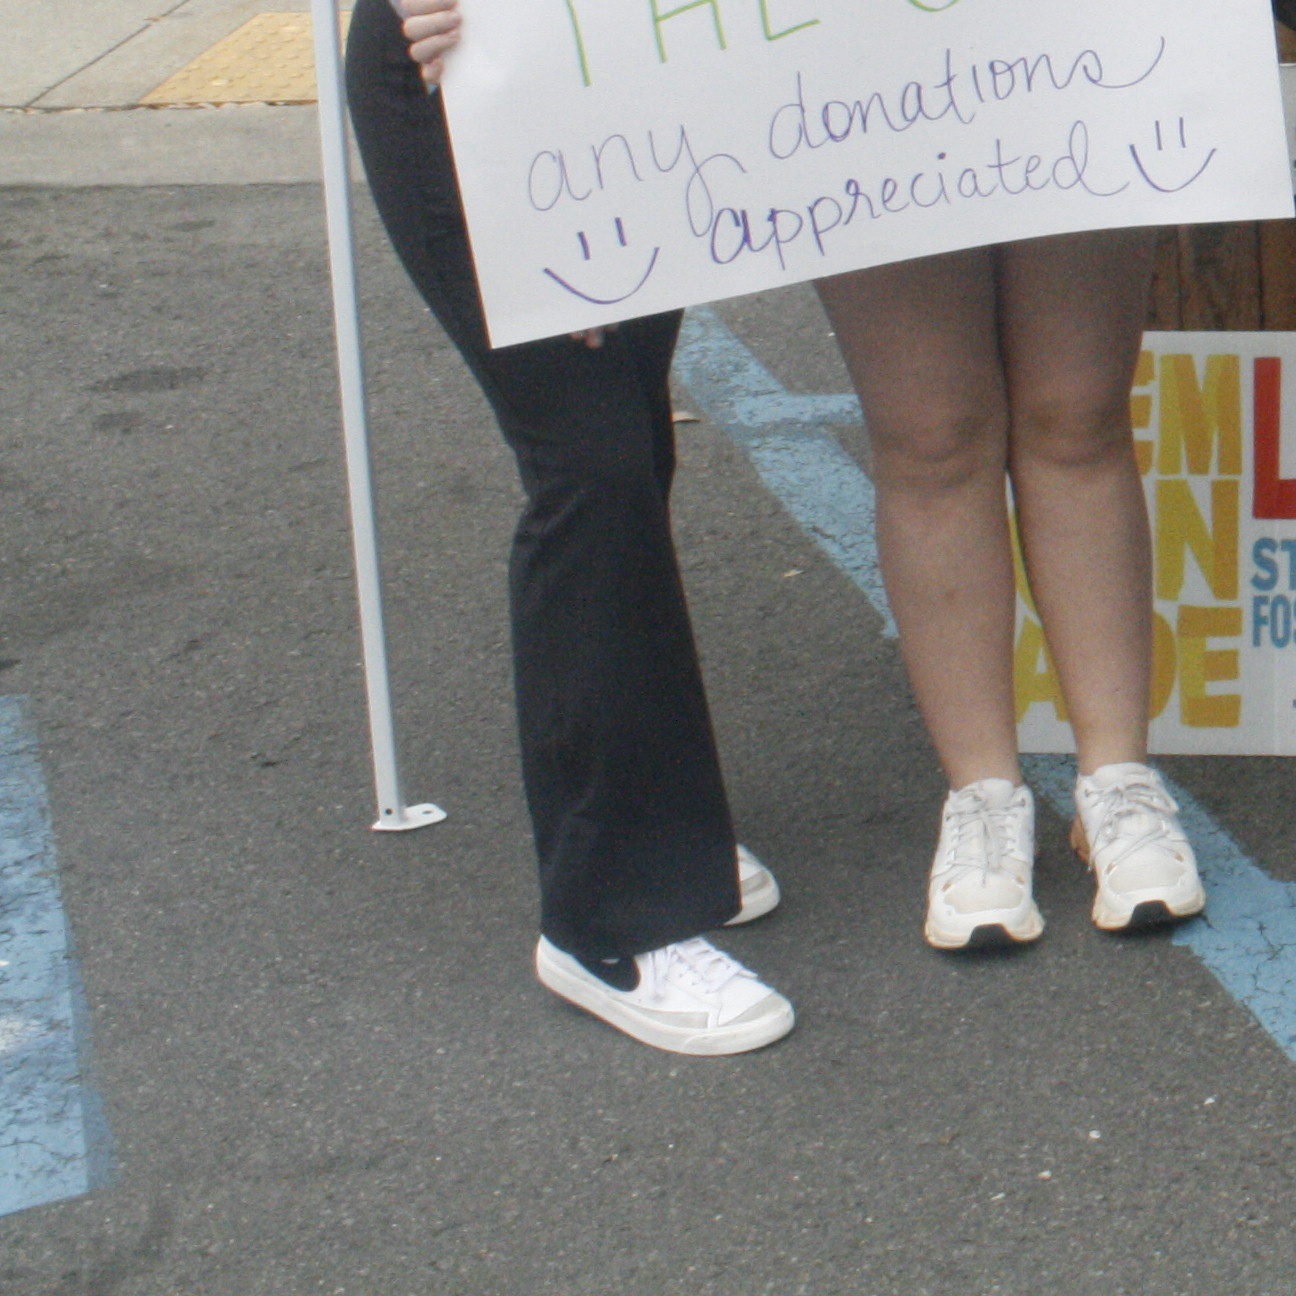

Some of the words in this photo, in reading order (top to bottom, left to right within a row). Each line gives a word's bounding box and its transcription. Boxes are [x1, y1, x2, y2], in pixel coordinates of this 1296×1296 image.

[527, 122, 748, 238] any
[768, 34, 1166, 161] donations
[708, 119, 1132, 272] appreciated
